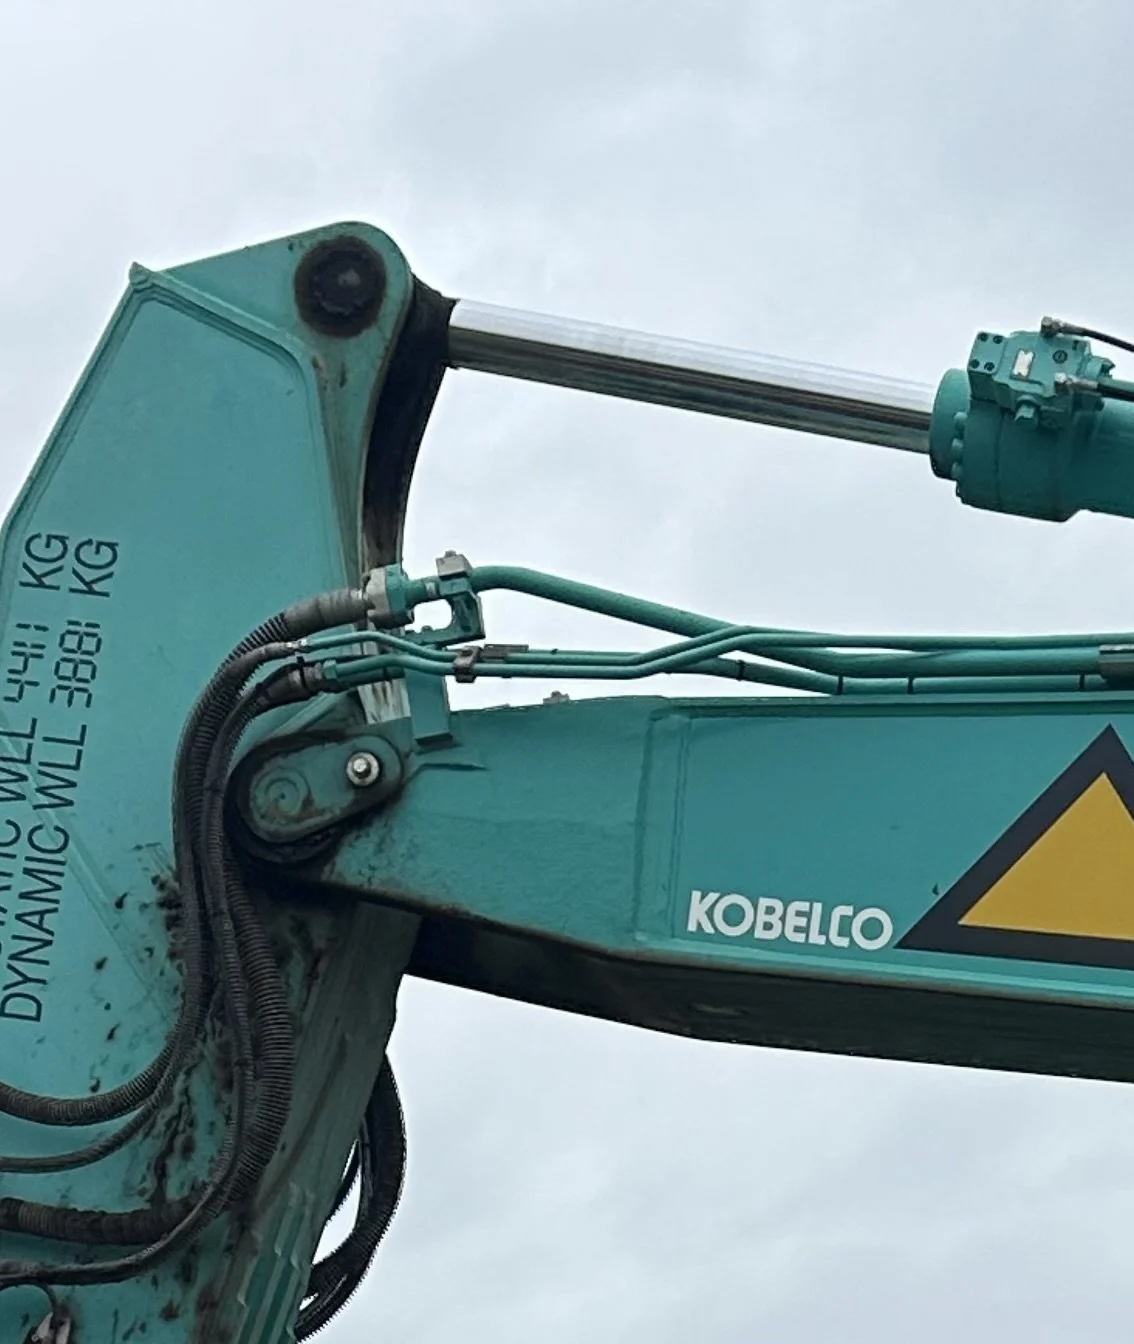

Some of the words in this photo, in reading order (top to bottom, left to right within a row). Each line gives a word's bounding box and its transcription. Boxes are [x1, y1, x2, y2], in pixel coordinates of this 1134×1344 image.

[18, 532, 70, 591] KG
[68, 538, 119, 598] KG
[49, 619, 102, 708] 3881
[32, 724, 87, 811] WLL
[0, 823, 70, 1023] DYNAMIC
[686, 889, 893, 951] KOBELCO
